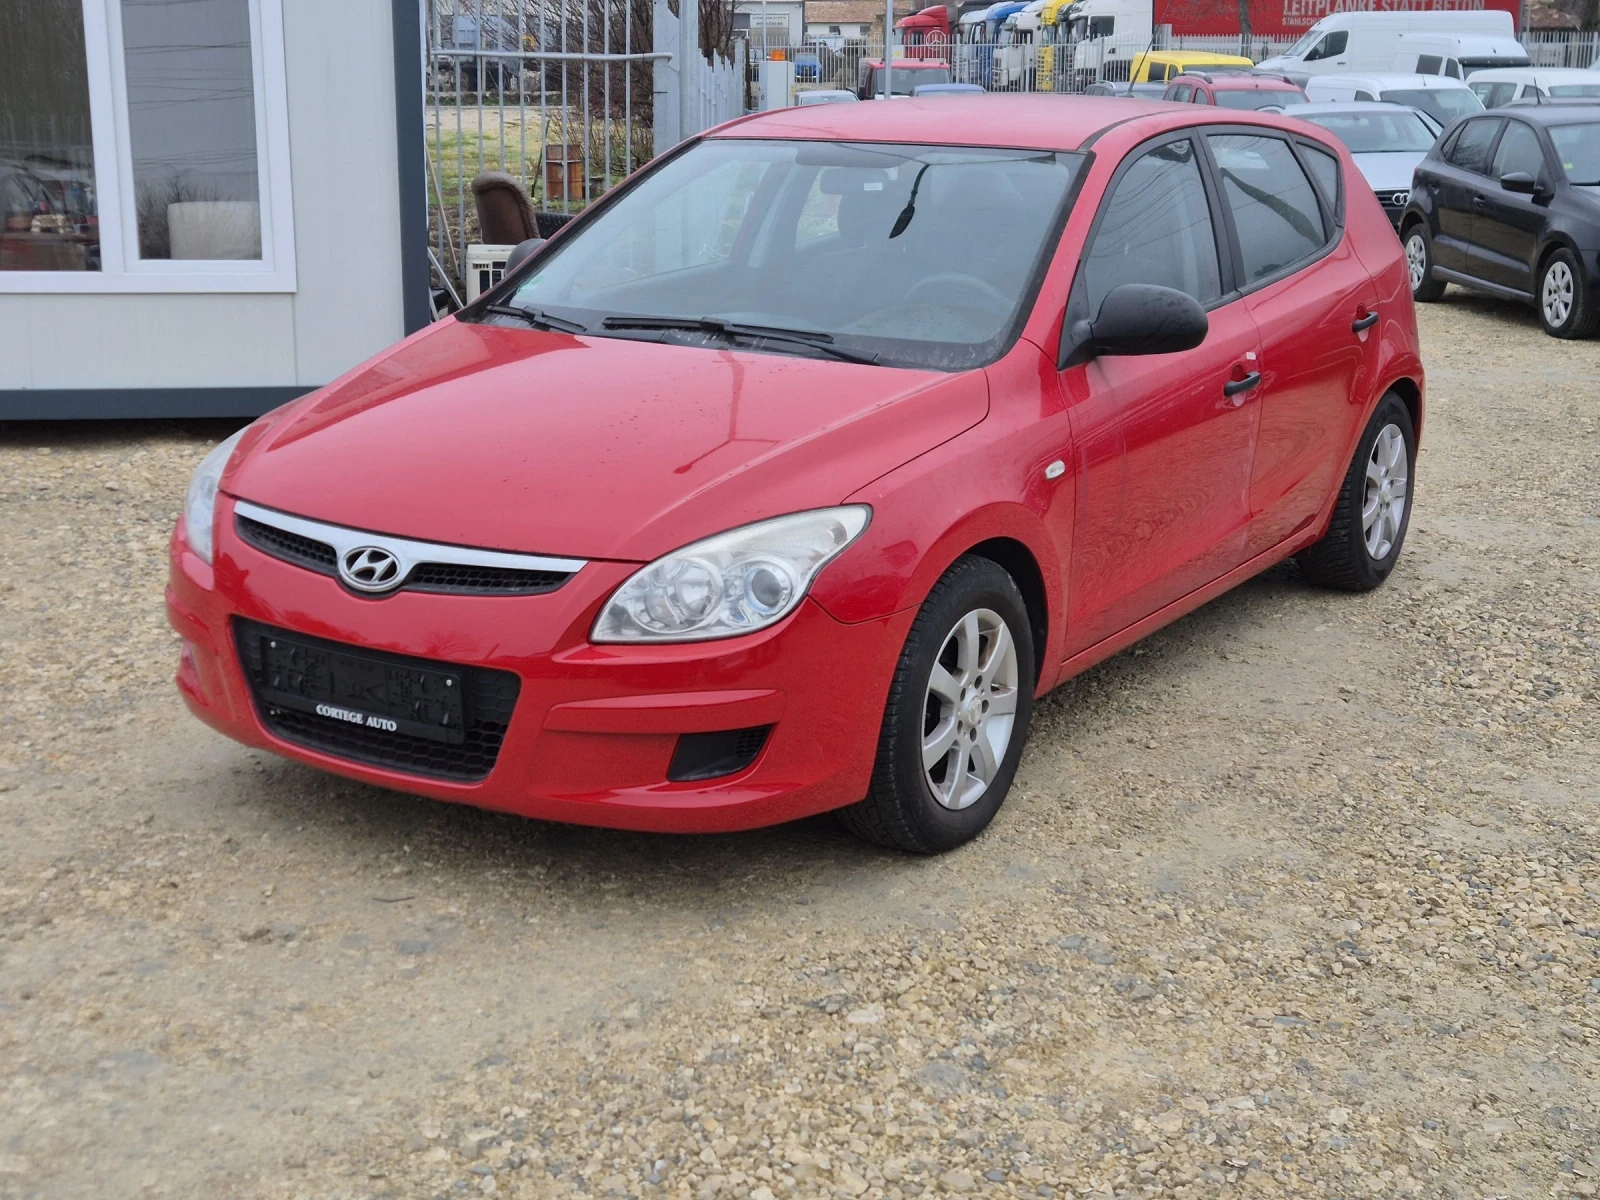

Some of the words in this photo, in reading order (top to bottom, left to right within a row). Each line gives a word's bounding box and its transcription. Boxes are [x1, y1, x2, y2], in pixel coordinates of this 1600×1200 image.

[1283, 0, 1376, 16] LEITPLANKE
[1380, 0, 1427, 11] STATT
[1432, 0, 1485, 11] BETON
[316, 704, 363, 724] CORTEGE
[366, 716, 397, 731] AUTO
